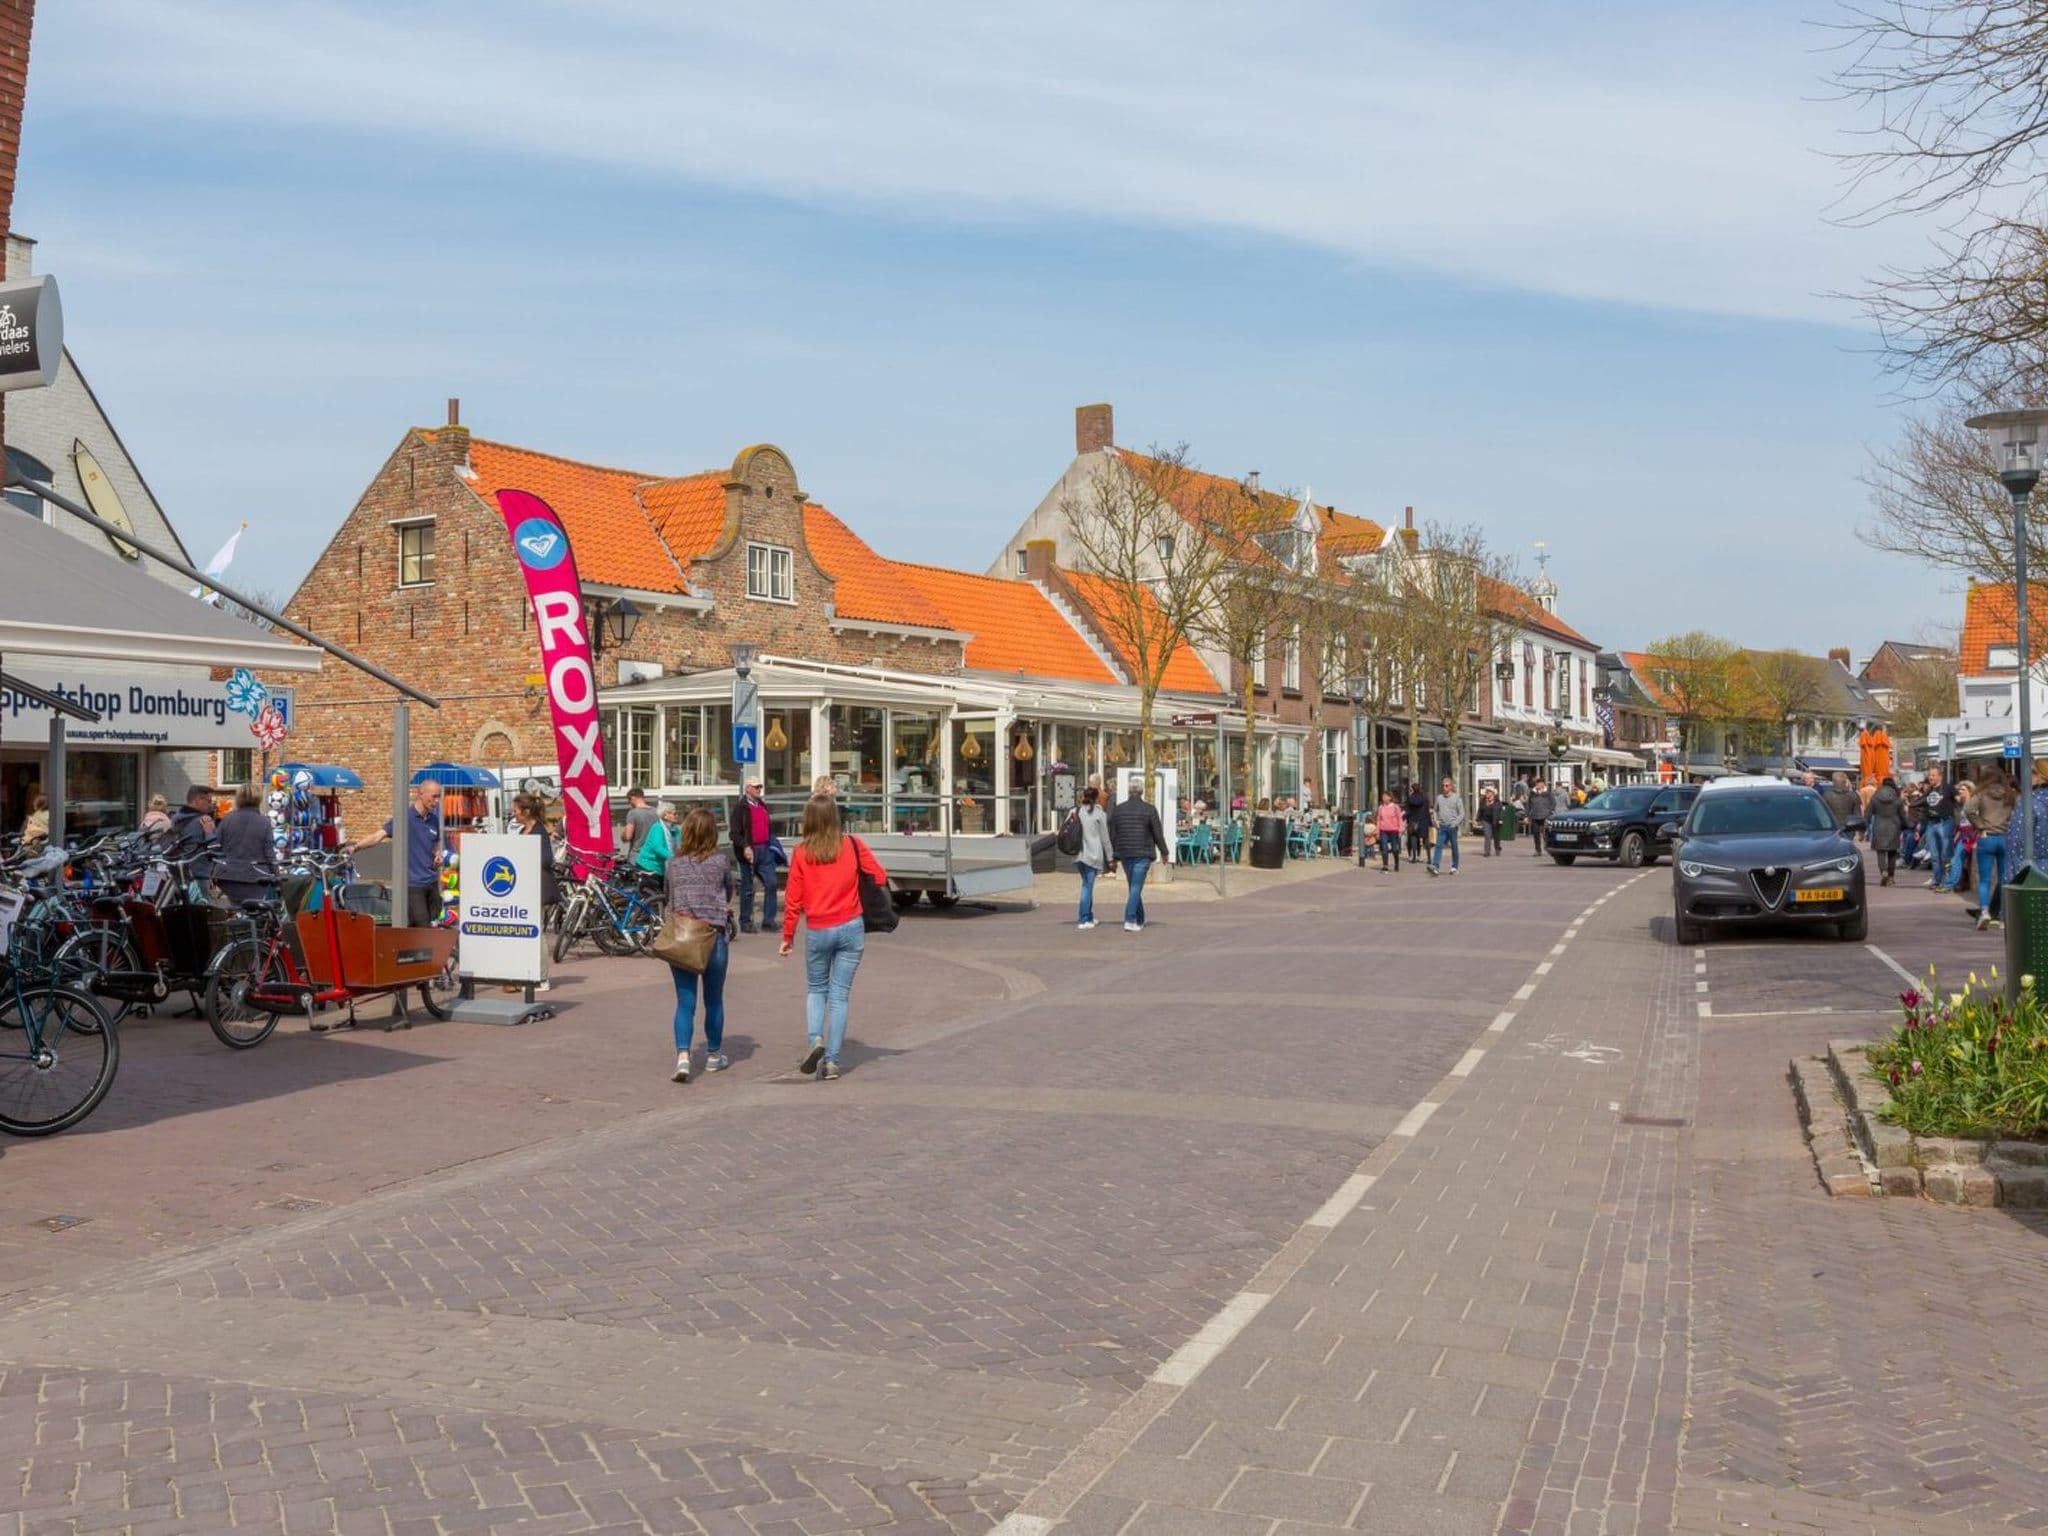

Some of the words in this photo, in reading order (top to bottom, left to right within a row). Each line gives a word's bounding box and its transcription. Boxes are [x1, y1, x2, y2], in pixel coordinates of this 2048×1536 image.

[0, 325, 29, 341] daas
[129, 686, 226, 725] Domburg
[532, 590, 607, 839] ROXY
[66, 729, 168, 743] www.sportshopdomburg.nl
[470, 905, 529, 919] Gazelle
[466, 924, 534, 937] VERHUURPUNT
